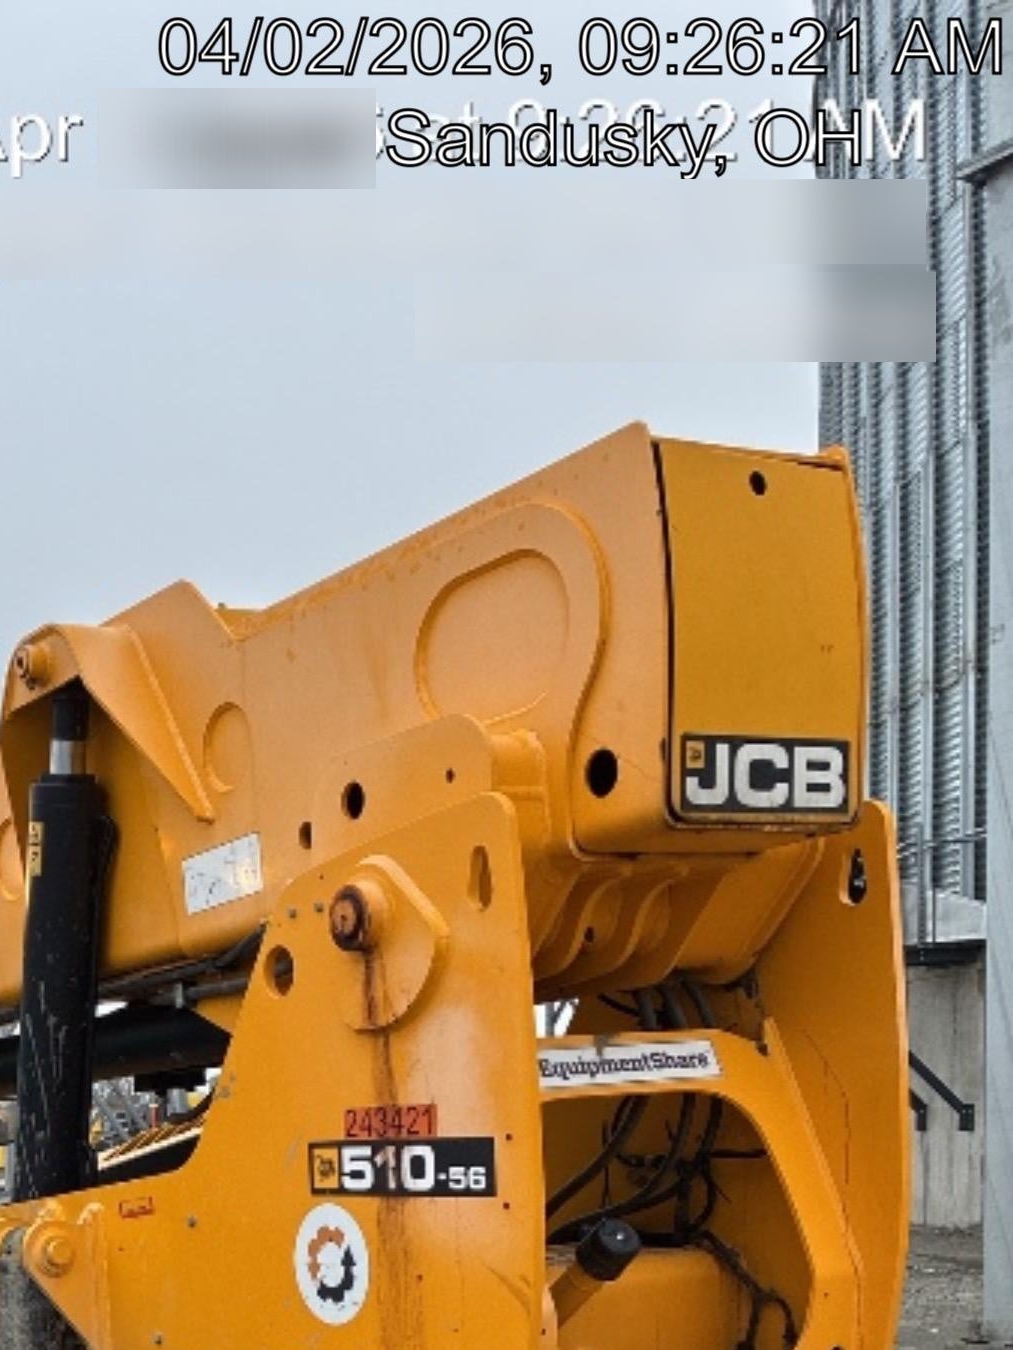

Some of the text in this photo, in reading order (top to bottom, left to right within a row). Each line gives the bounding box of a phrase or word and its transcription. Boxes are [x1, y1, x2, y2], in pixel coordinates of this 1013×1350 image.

[685, 742, 846, 808] JCB
[539, 1050, 710, 1080] EquipmentShare
[346, 1104, 433, 1138] 243421
[340, 1144, 486, 1191] 510-56
